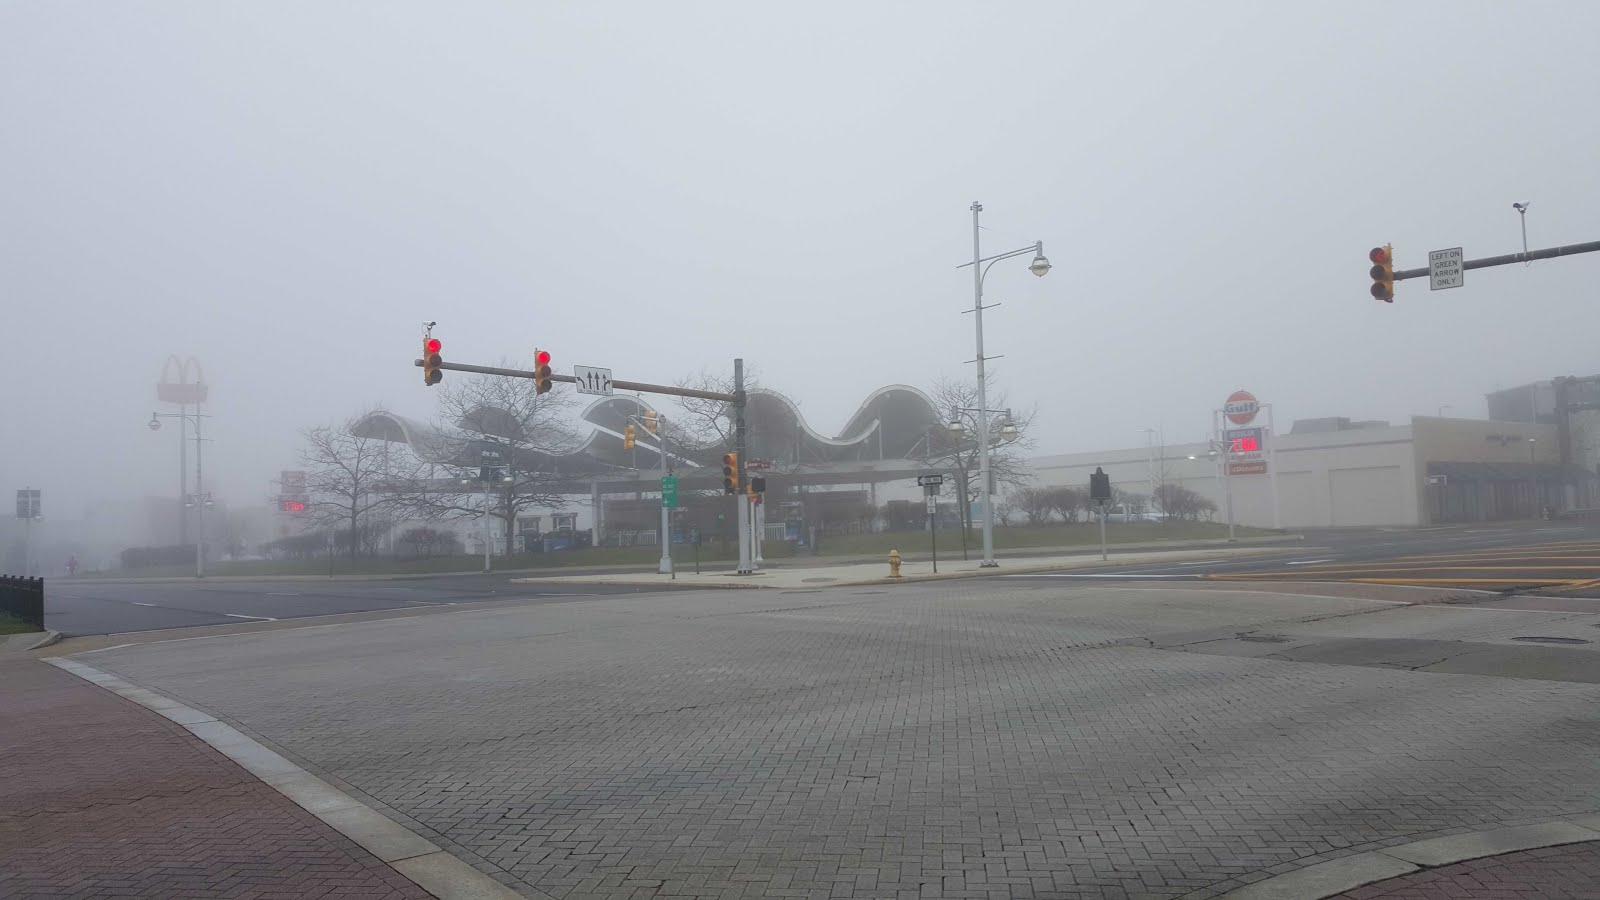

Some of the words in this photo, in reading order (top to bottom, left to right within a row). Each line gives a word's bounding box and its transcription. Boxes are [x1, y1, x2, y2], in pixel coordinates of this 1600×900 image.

[1432, 252, 1448, 260] LEFT
[1450, 250, 1460, 258] ON
[1434, 260, 1458, 268] GREEN
[1434, 268, 1459, 278] ARROW
[1438, 277, 1456, 286] ONLY
[1226, 402, 1255, 412] Gulf
